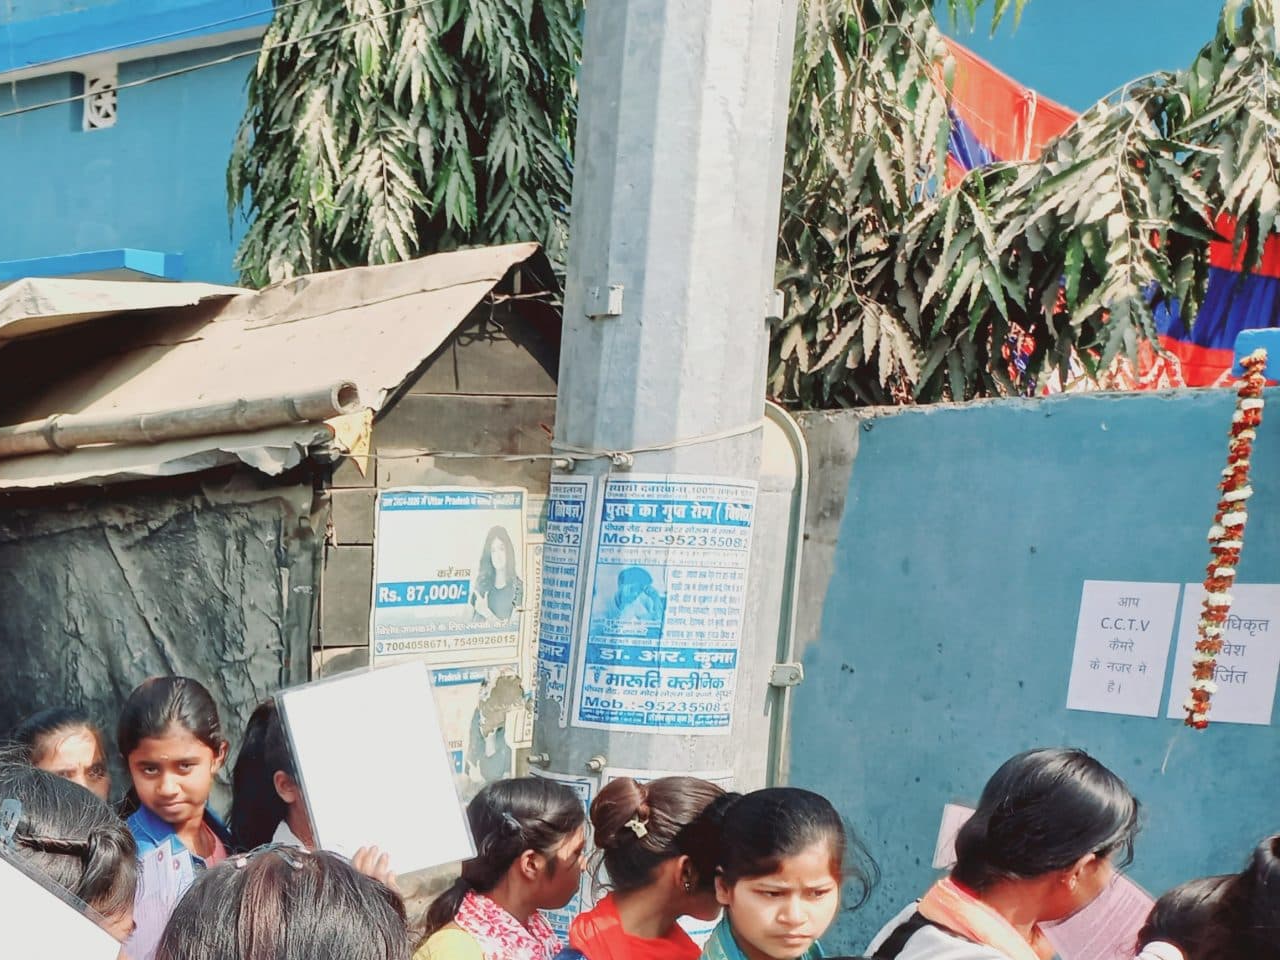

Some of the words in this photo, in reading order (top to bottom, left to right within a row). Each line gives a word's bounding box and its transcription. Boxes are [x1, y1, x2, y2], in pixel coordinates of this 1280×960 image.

[638, 504, 658, 517] का
[691, 502, 713, 519] रोग
[379, 587, 402, 603] Rs.
[406, 584, 467, 604] 87,000/-
[1118, 597, 1141, 608] आप
[1100, 617, 1151, 632] C.C.T.V
[599, 647, 631, 661] डा.
[638, 649, 687, 664] आर.
[1106, 662, 1132, 673] नजर
